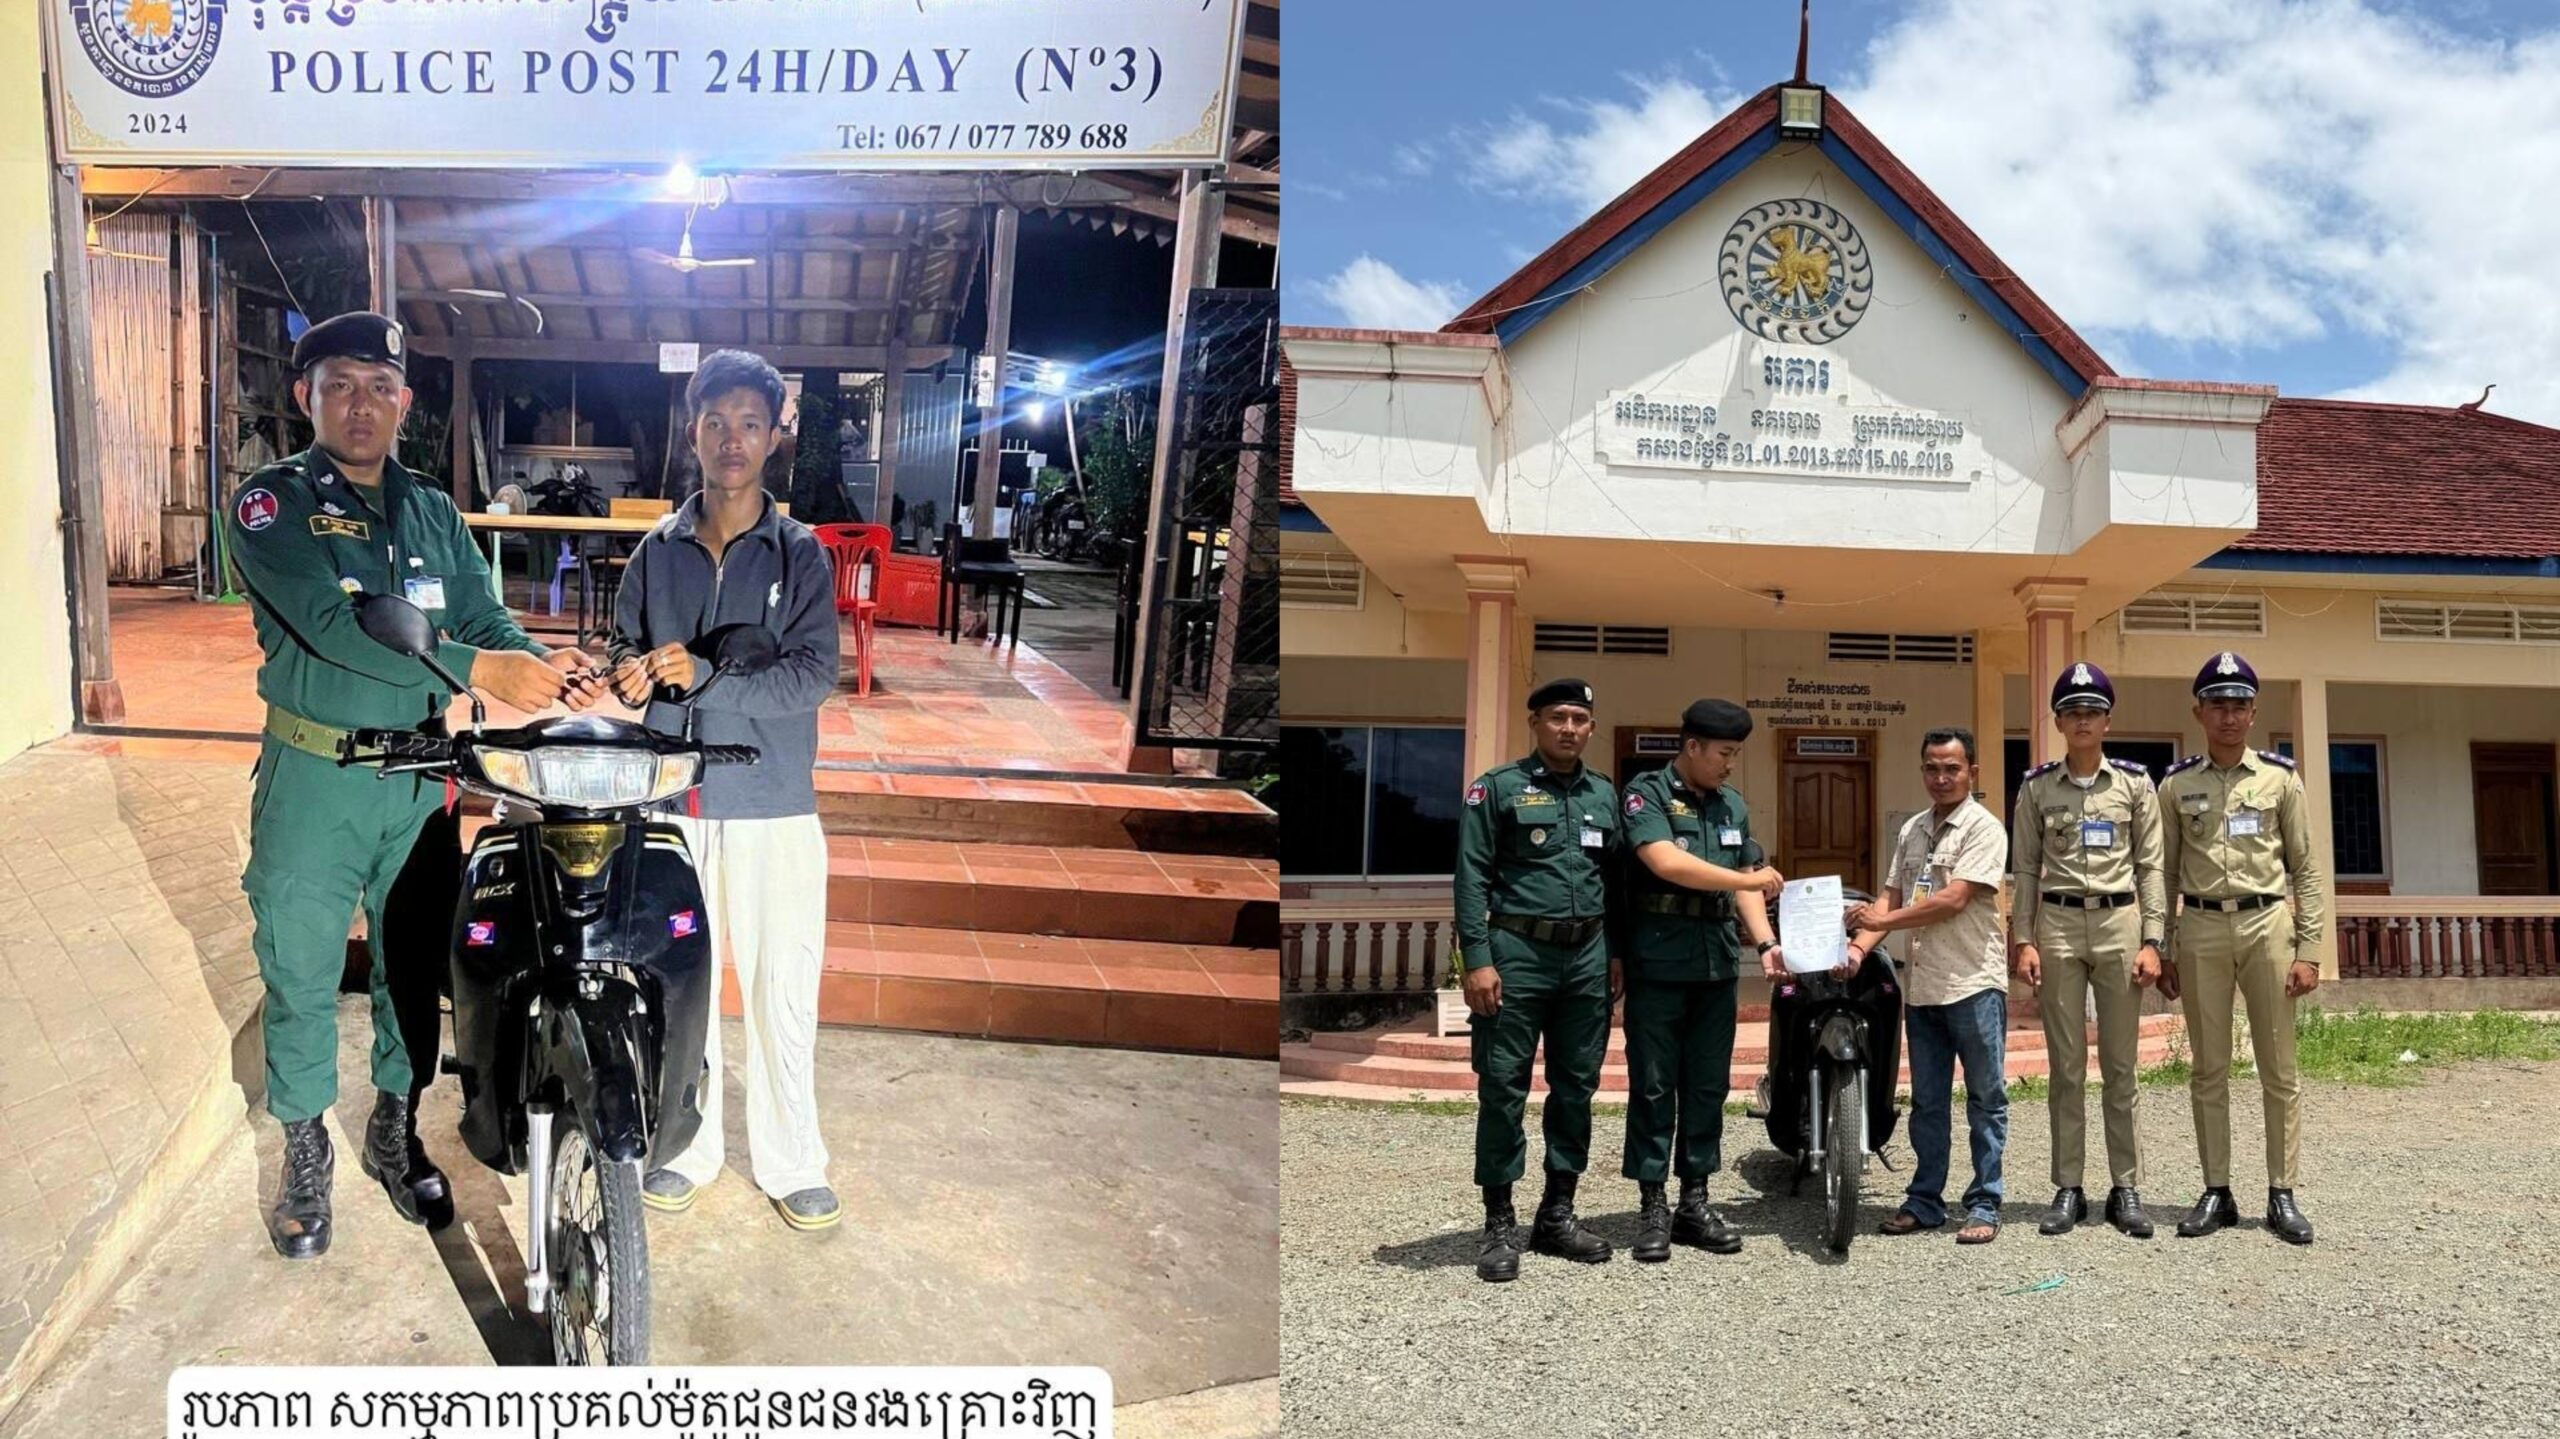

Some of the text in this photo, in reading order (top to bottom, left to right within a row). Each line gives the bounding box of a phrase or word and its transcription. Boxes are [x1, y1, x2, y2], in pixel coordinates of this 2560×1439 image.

[269, 49, 494, 94] POLICE
[523, 49, 679, 94] POST
[704, 47, 970, 95] 24H/DAY
[127, 112, 188, 135] 2024
[836, 123, 1129, 150] Tel: 067 / 077 789 688
[1763, 355, 1830, 390] អគារ
[1614, 394, 1717, 433] អធិការដ្ឋាន
[1750, 409, 1822, 434] នគរបាល
